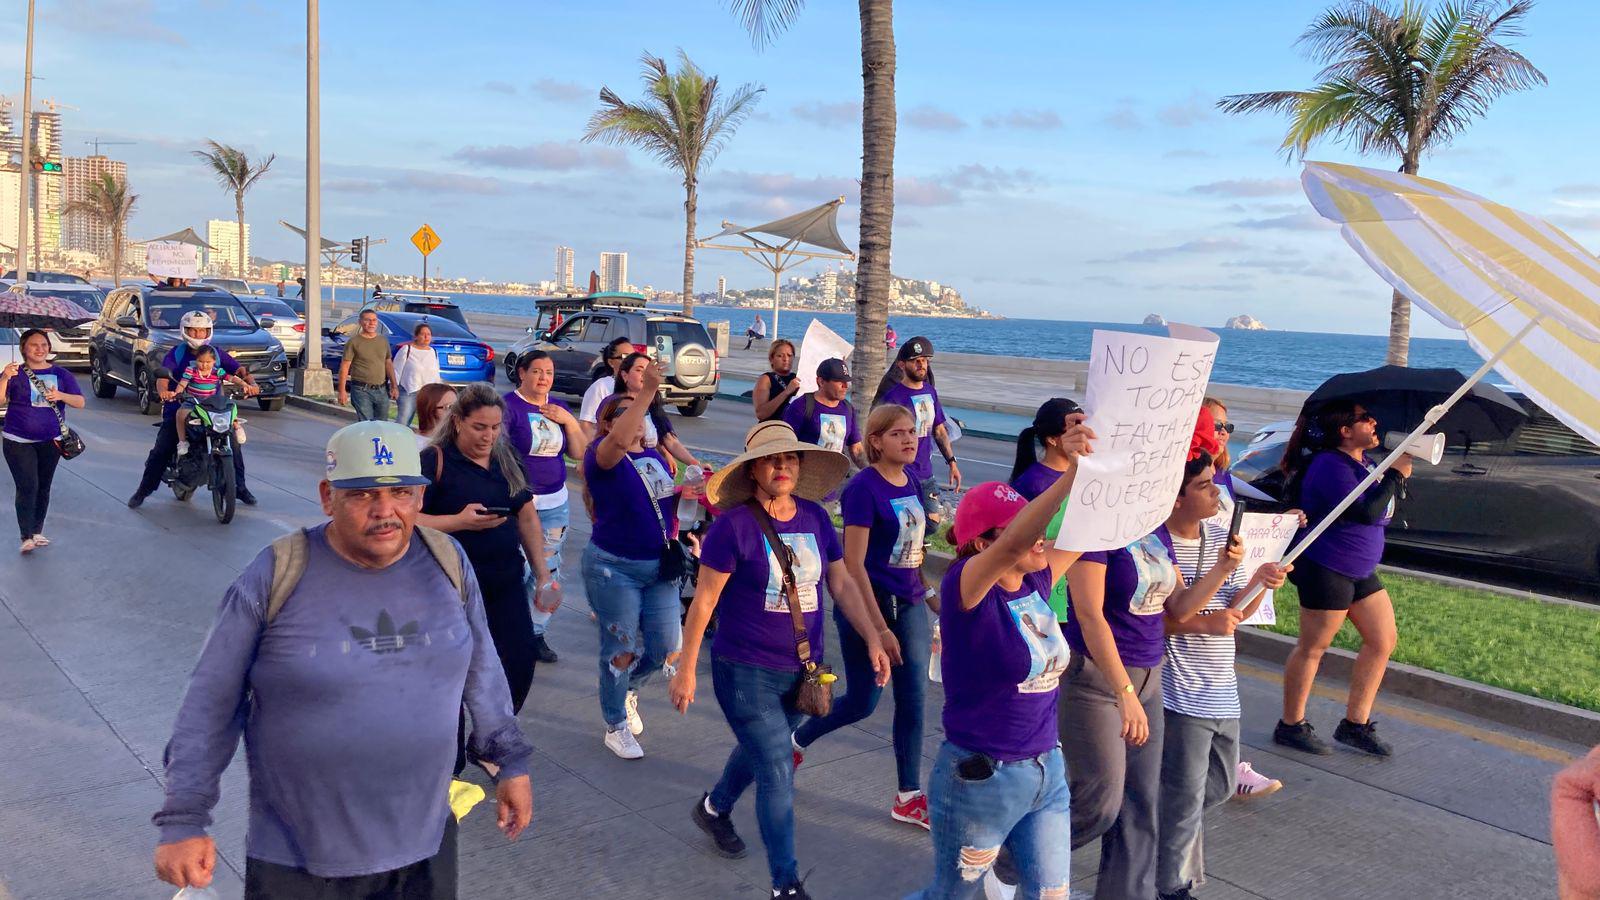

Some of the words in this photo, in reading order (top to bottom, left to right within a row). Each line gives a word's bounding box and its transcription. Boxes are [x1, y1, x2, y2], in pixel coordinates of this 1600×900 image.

[1104, 344, 1149, 375] NO
[1171, 352, 1213, 381] EST
[1110, 418, 1177, 449] FALTA
[372, 437, 394, 465] LA
[1271, 527, 1293, 540] QUE
[1250, 546, 1265, 559] NO
